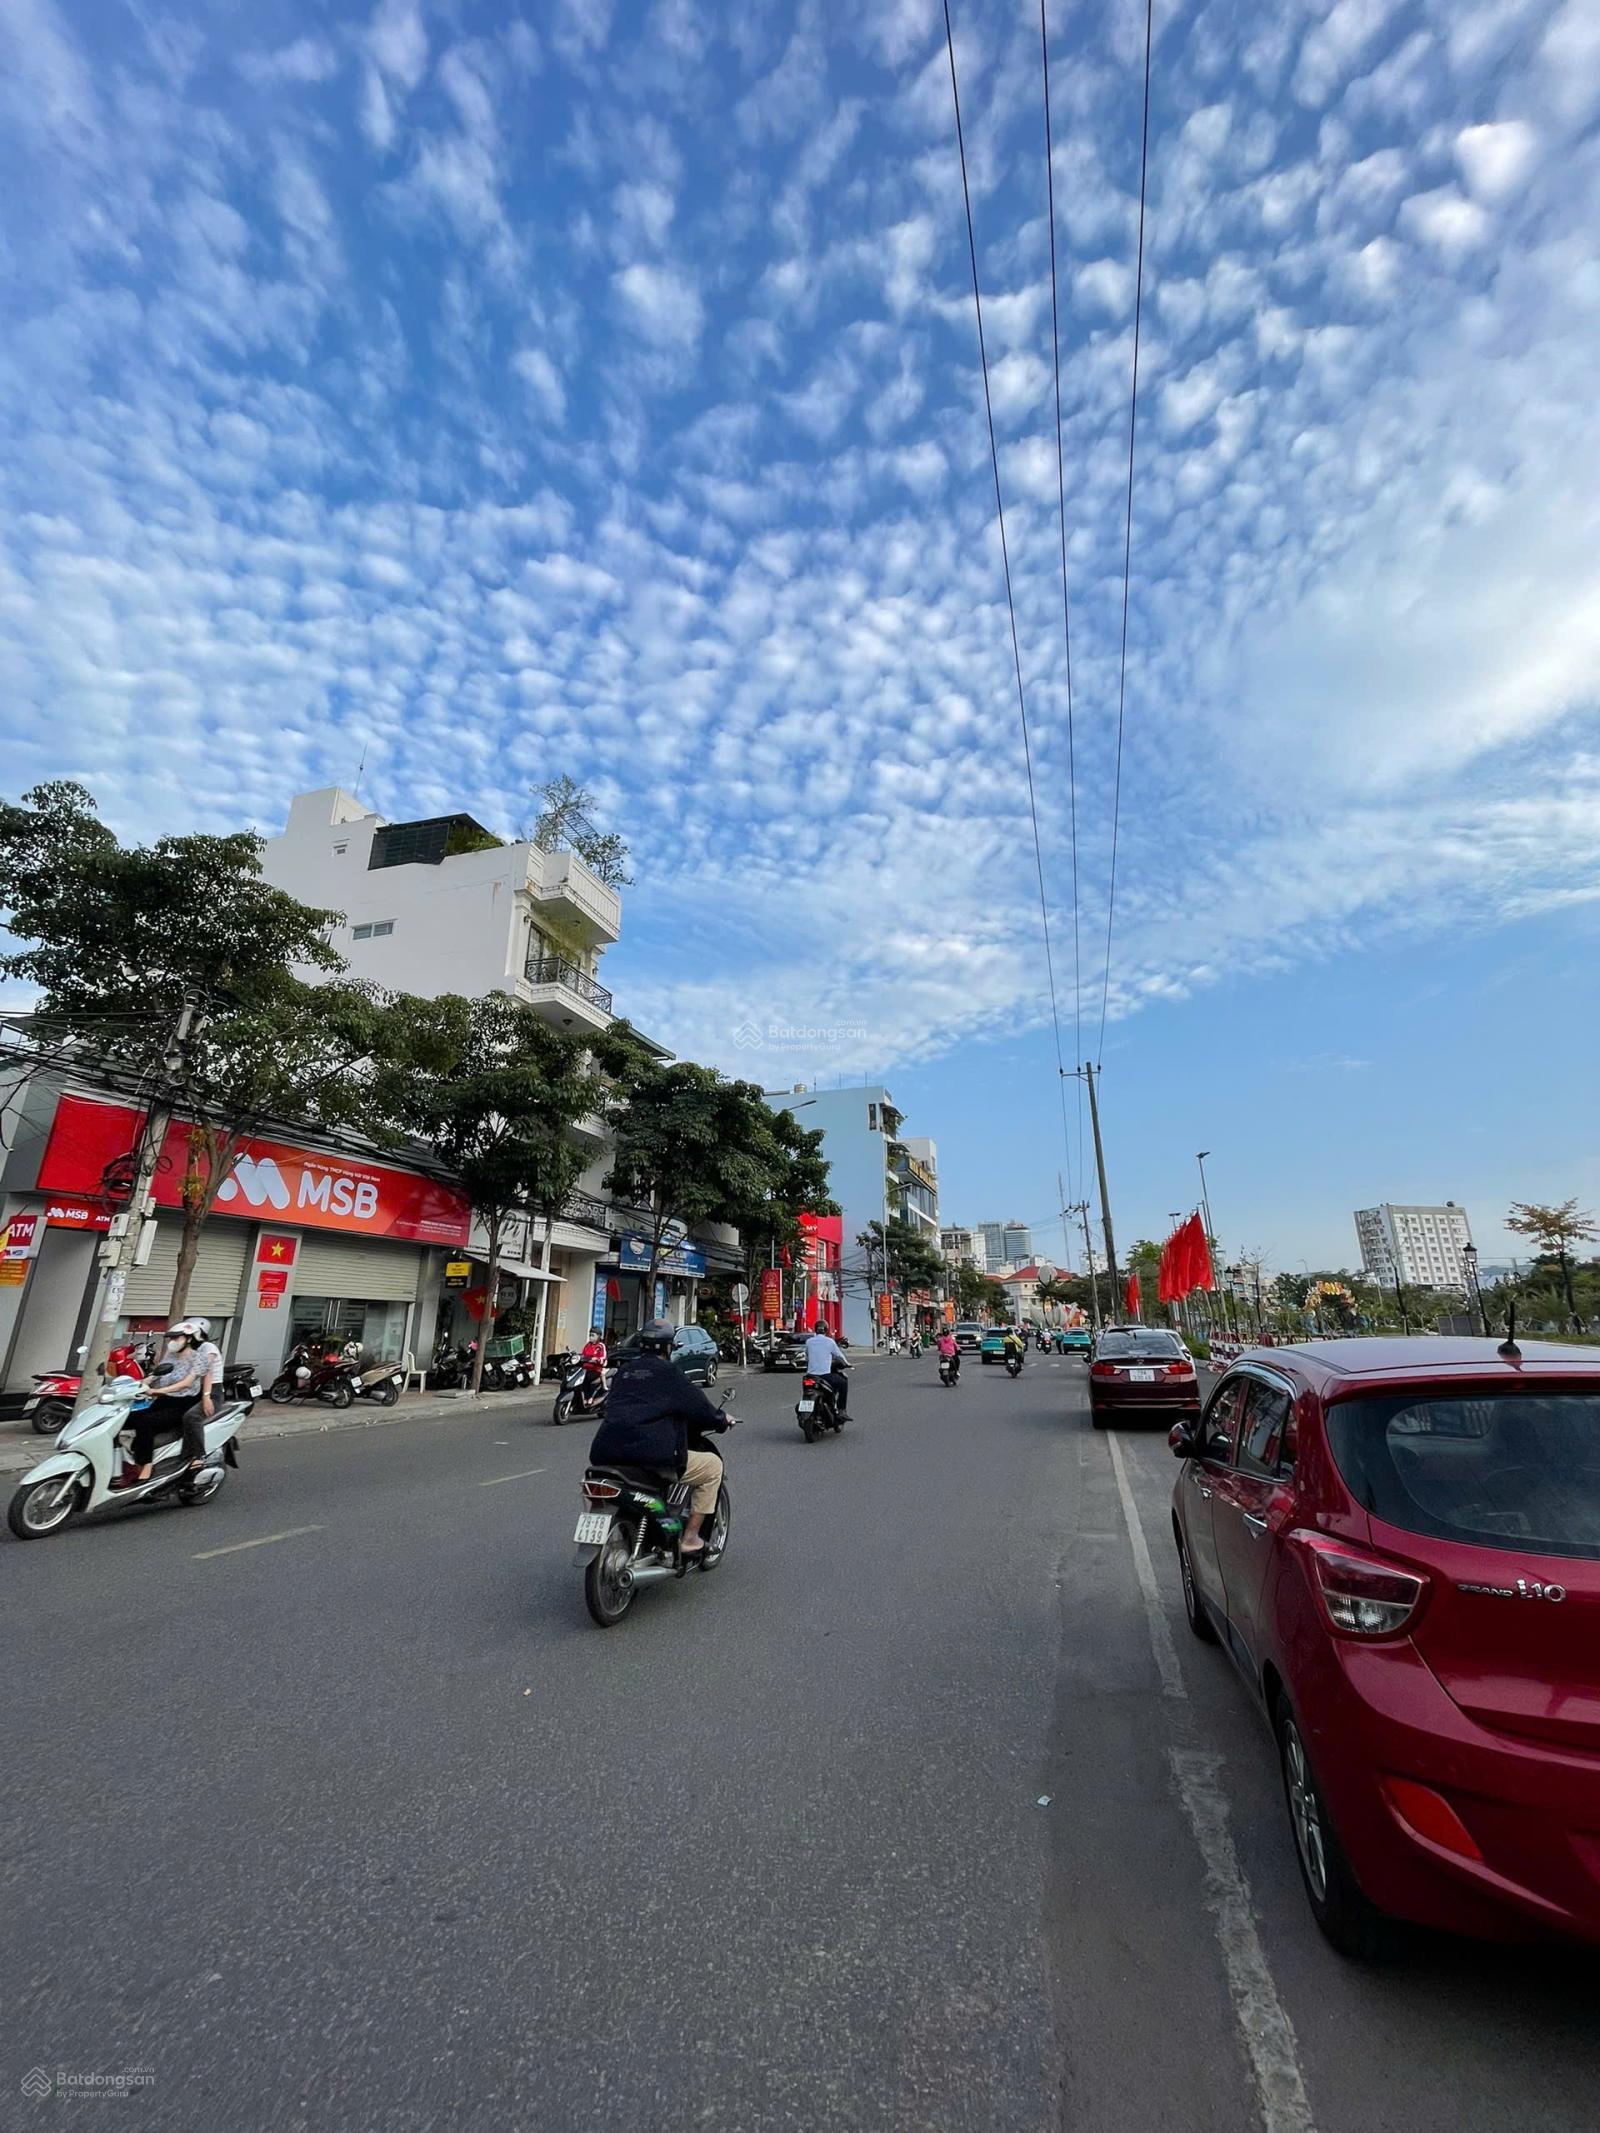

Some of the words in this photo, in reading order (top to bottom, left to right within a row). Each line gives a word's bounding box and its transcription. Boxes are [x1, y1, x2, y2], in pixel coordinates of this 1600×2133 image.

[297, 1170, 379, 1219] MSB
[65, 1210, 89, 1220] MSB
[95, 1215, 111, 1223] ATM
[8, 1223, 35, 1238] ATM
[1457, 1584, 1514, 1597] GRAND
[1516, 1579, 1567, 1602] i10
